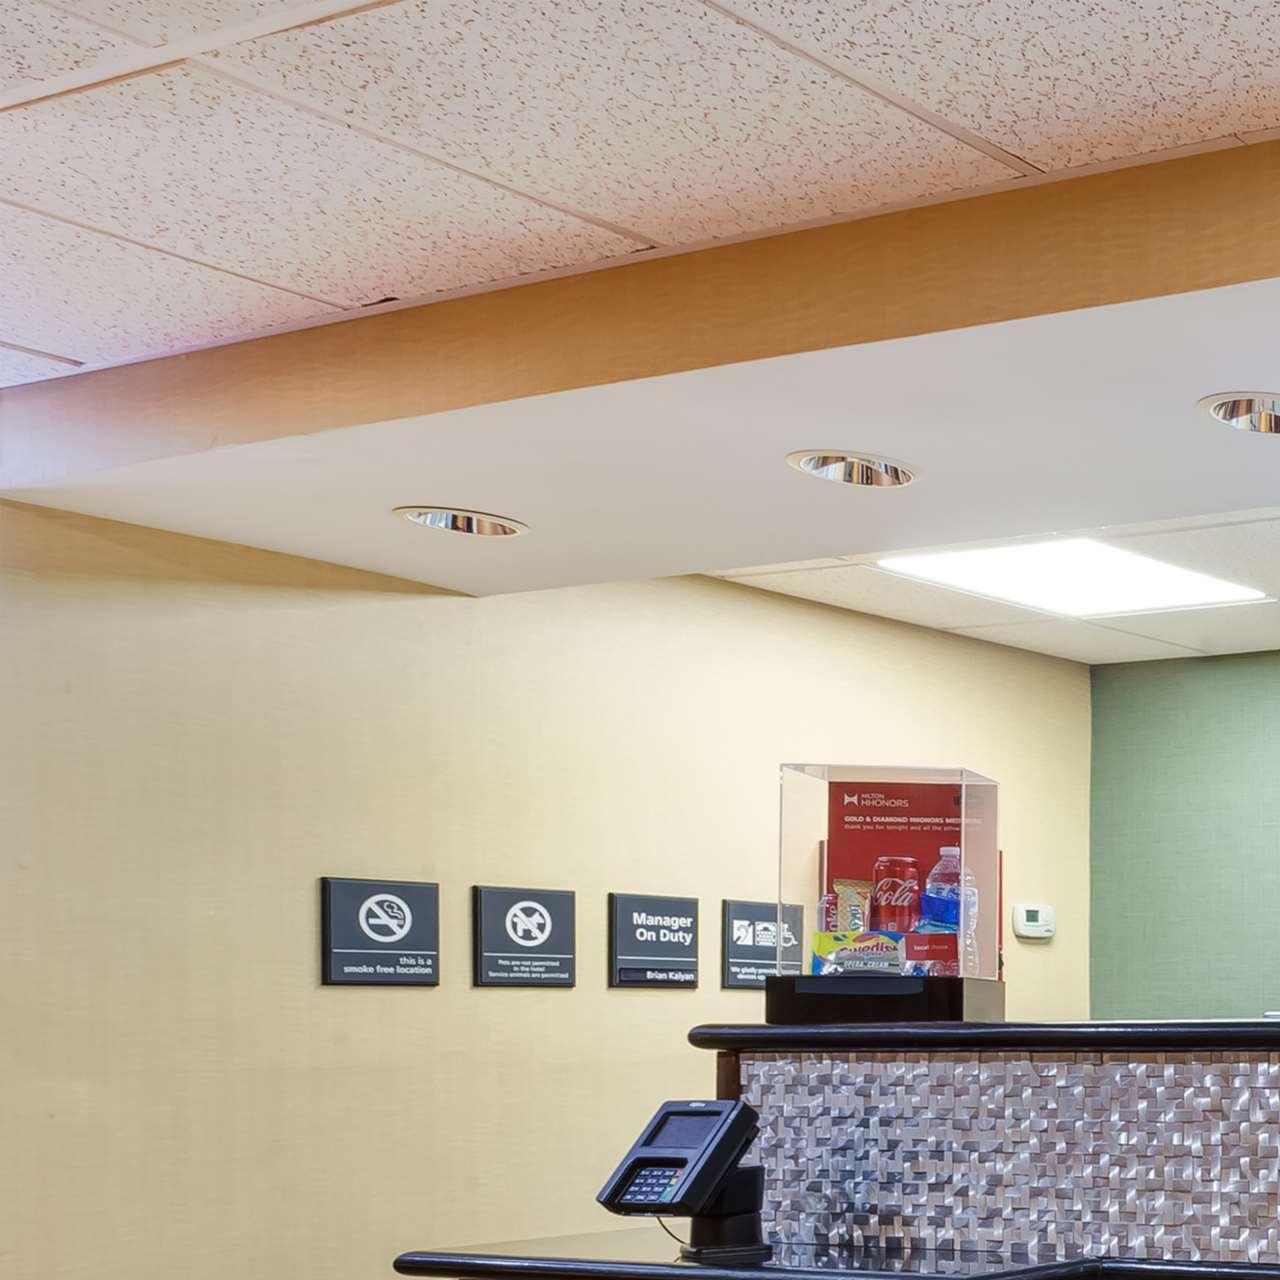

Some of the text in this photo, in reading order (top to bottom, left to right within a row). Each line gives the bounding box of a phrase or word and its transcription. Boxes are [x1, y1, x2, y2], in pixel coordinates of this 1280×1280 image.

[632, 911, 693, 930] Manager
[635, 927, 693, 946] On Duty
[399, 956, 417, 966] this
[418, 956, 426, 966] is
[343, 964, 433, 975] smoke free location
[646, 970, 667, 980] Brian
